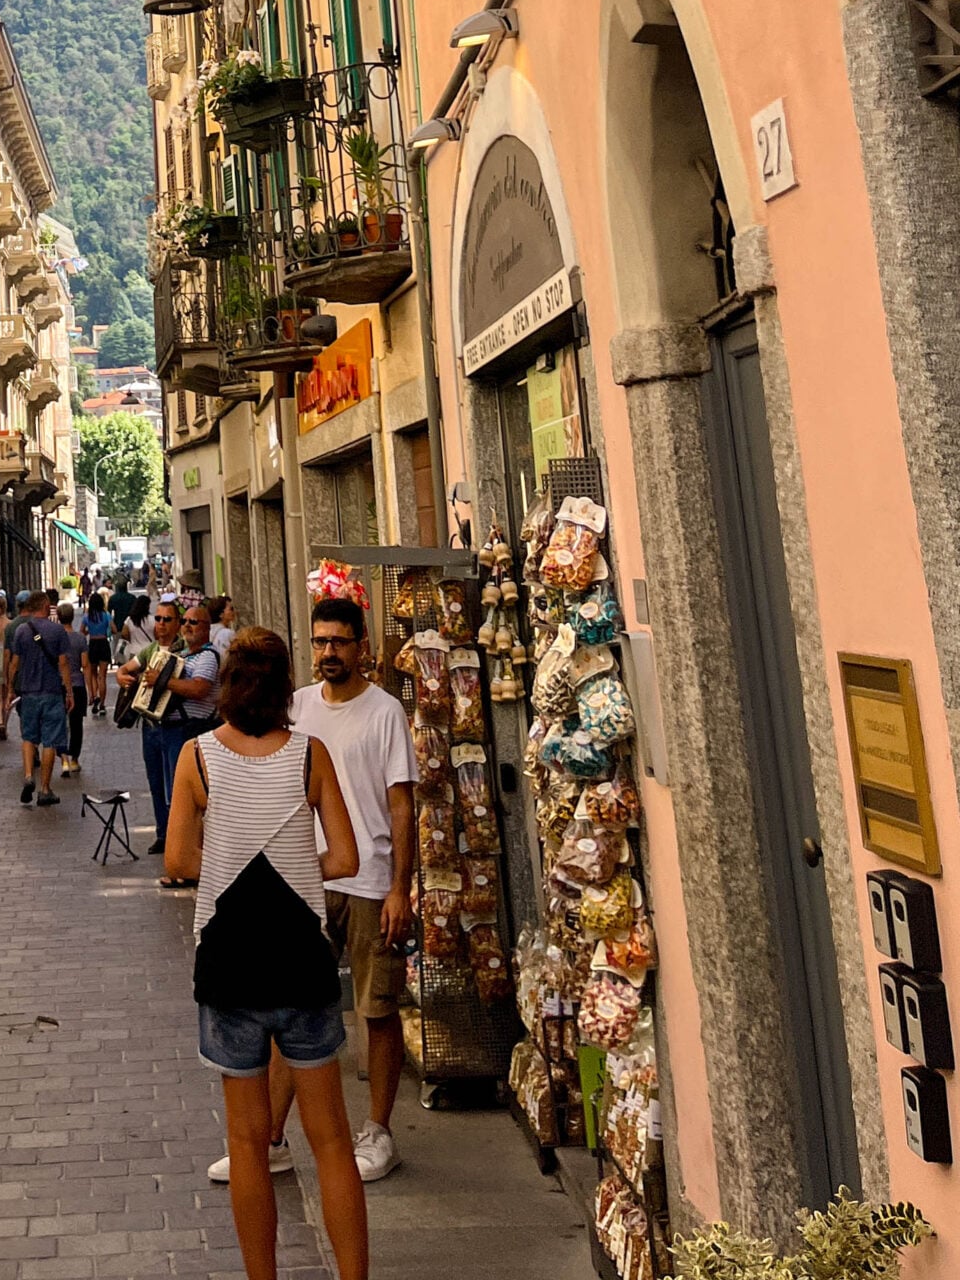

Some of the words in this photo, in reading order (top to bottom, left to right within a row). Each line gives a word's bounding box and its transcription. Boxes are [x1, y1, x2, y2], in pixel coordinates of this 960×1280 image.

[757, 117, 782, 182] 27
[466, 343, 479, 368] FREE
[479, 323, 506, 360] ENTRANCE
[512, 304, 530, 336] OPEN
[531, 295, 542, 322] NO
[545, 279, 563, 314] STOP
